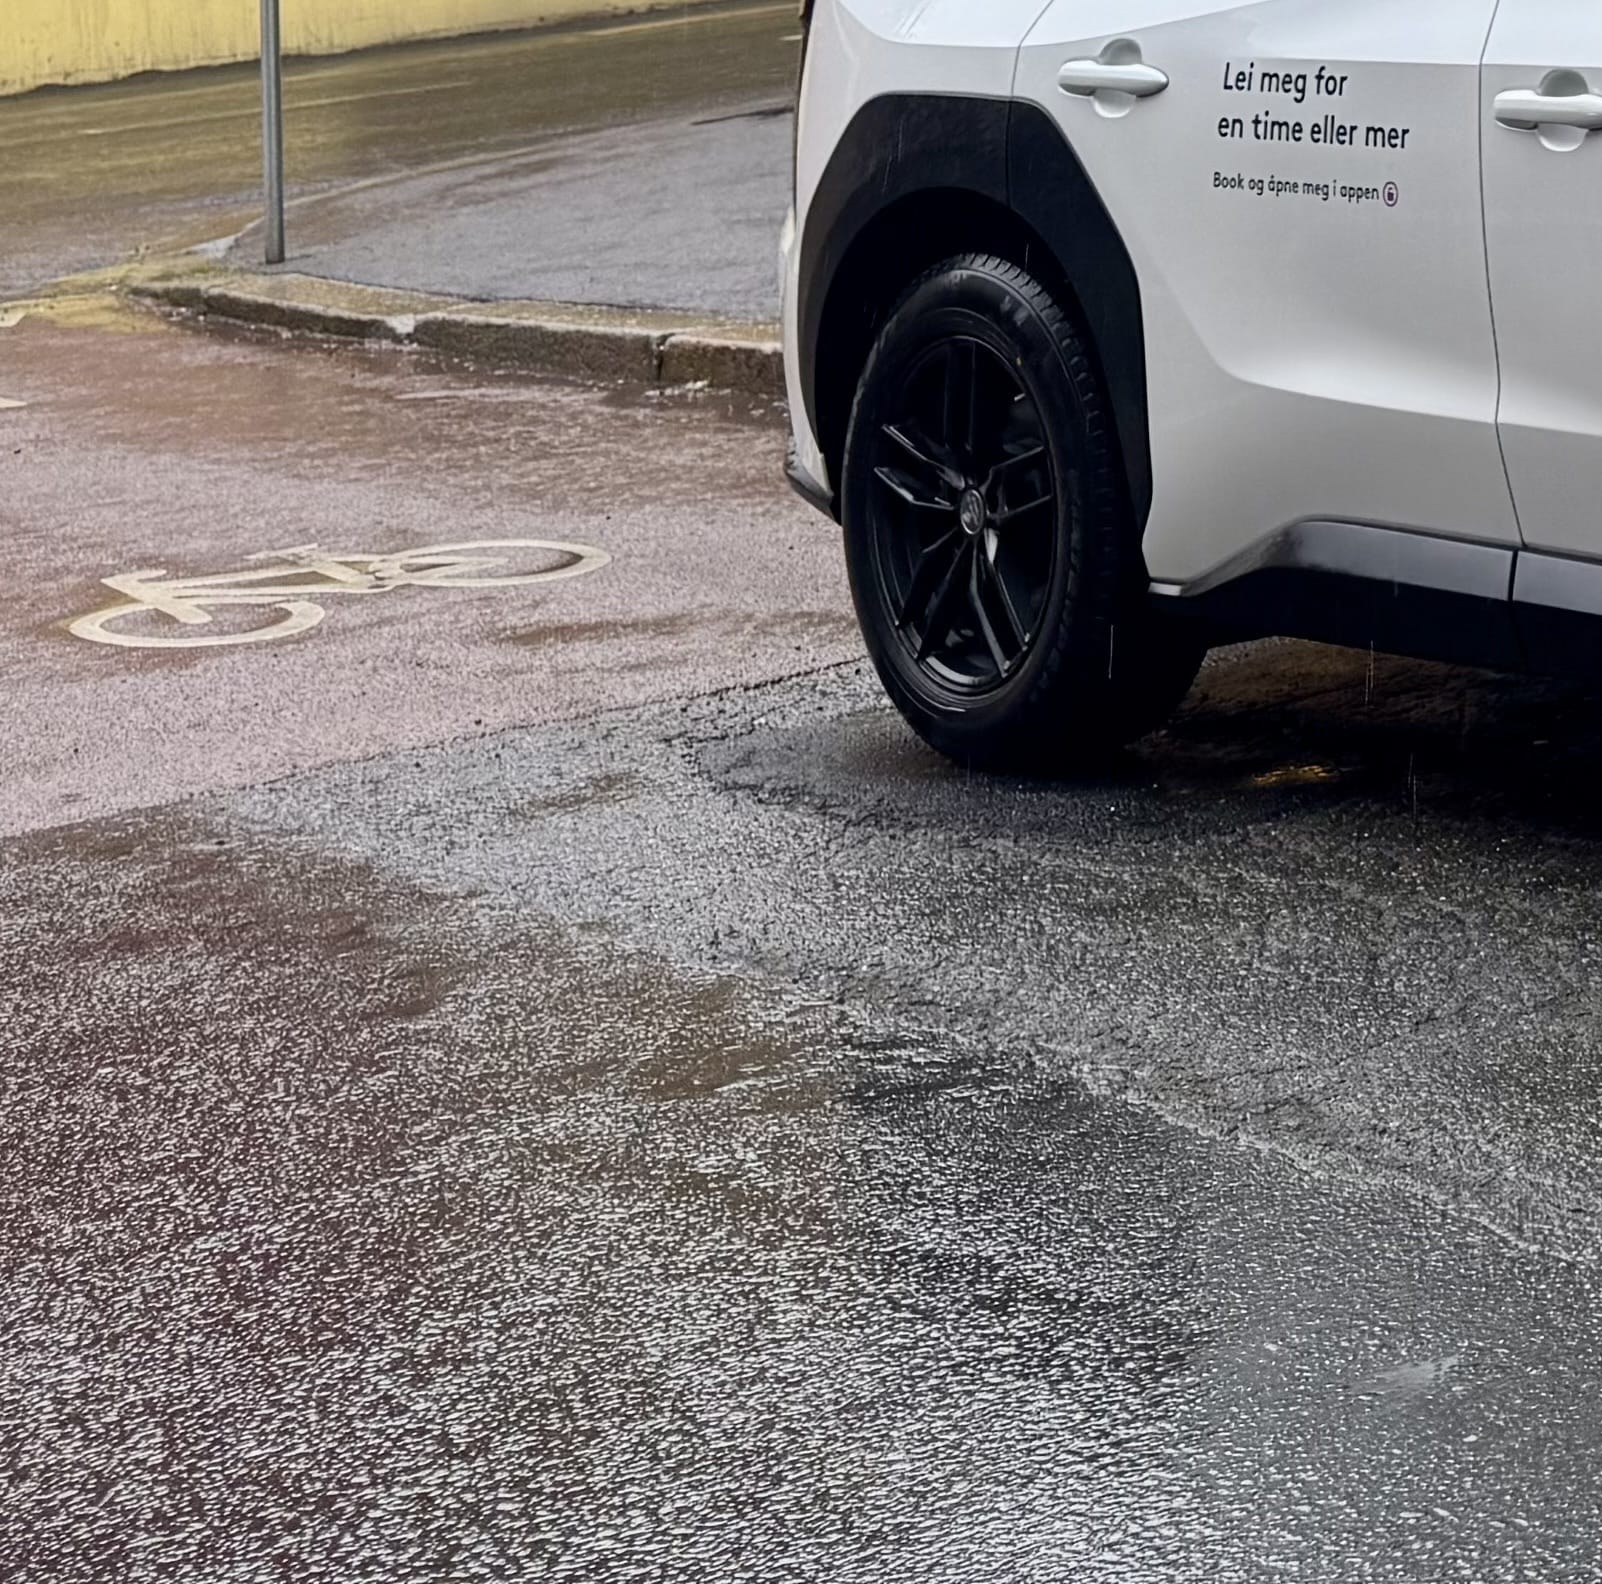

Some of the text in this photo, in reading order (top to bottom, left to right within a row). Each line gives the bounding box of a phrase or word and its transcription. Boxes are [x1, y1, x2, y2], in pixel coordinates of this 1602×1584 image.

[1223, 61, 1349, 103] Lei meg for
[1217, 110, 1411, 149] en time eller mer
[1212, 171, 1380, 204] Book og åpne meg i appen
